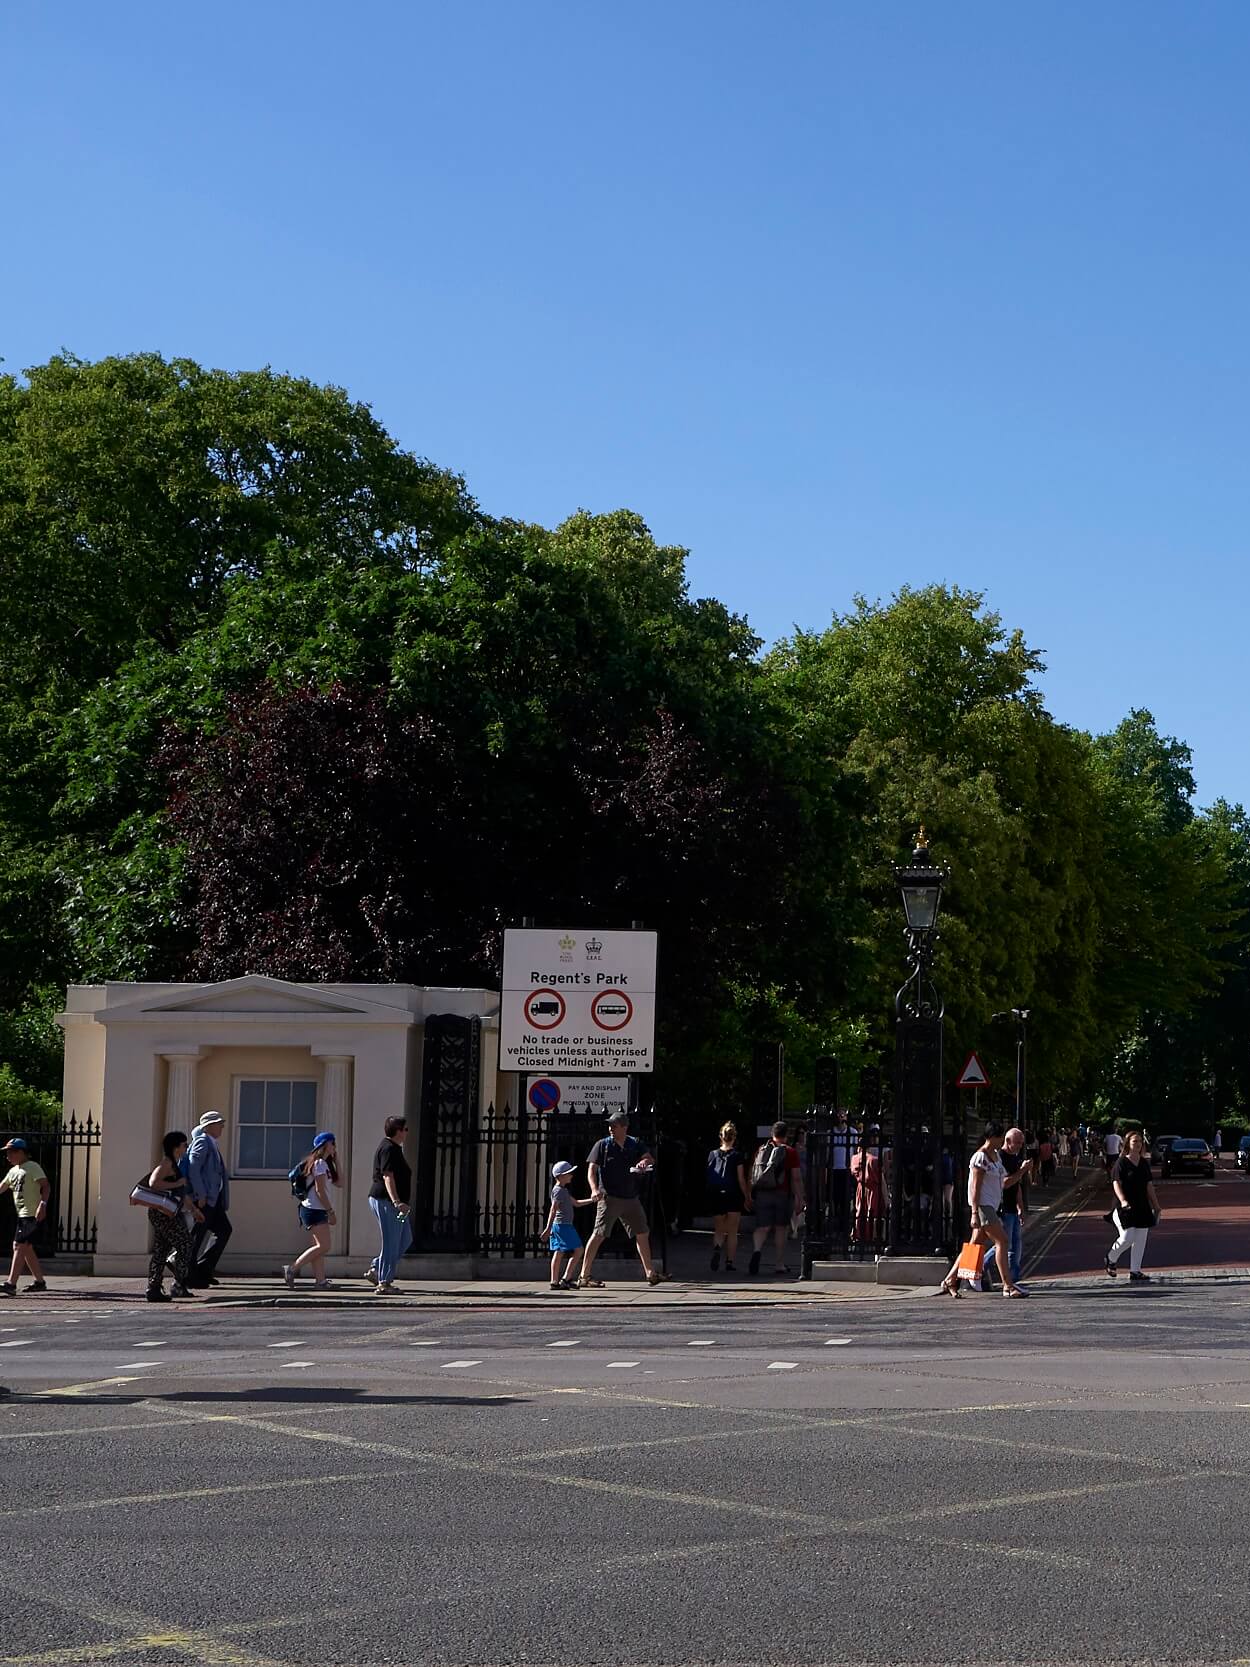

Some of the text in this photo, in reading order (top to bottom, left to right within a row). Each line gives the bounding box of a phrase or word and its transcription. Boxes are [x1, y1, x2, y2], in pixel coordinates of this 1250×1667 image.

[530, 971, 628, 986] Regent's Park
[522, 1035, 633, 1046] No trade or business
[507, 1046, 648, 1057] vehicles unless authorised
[517, 1057, 554, 1066] Closed
[558, 1057, 604, 1068] Midnight
